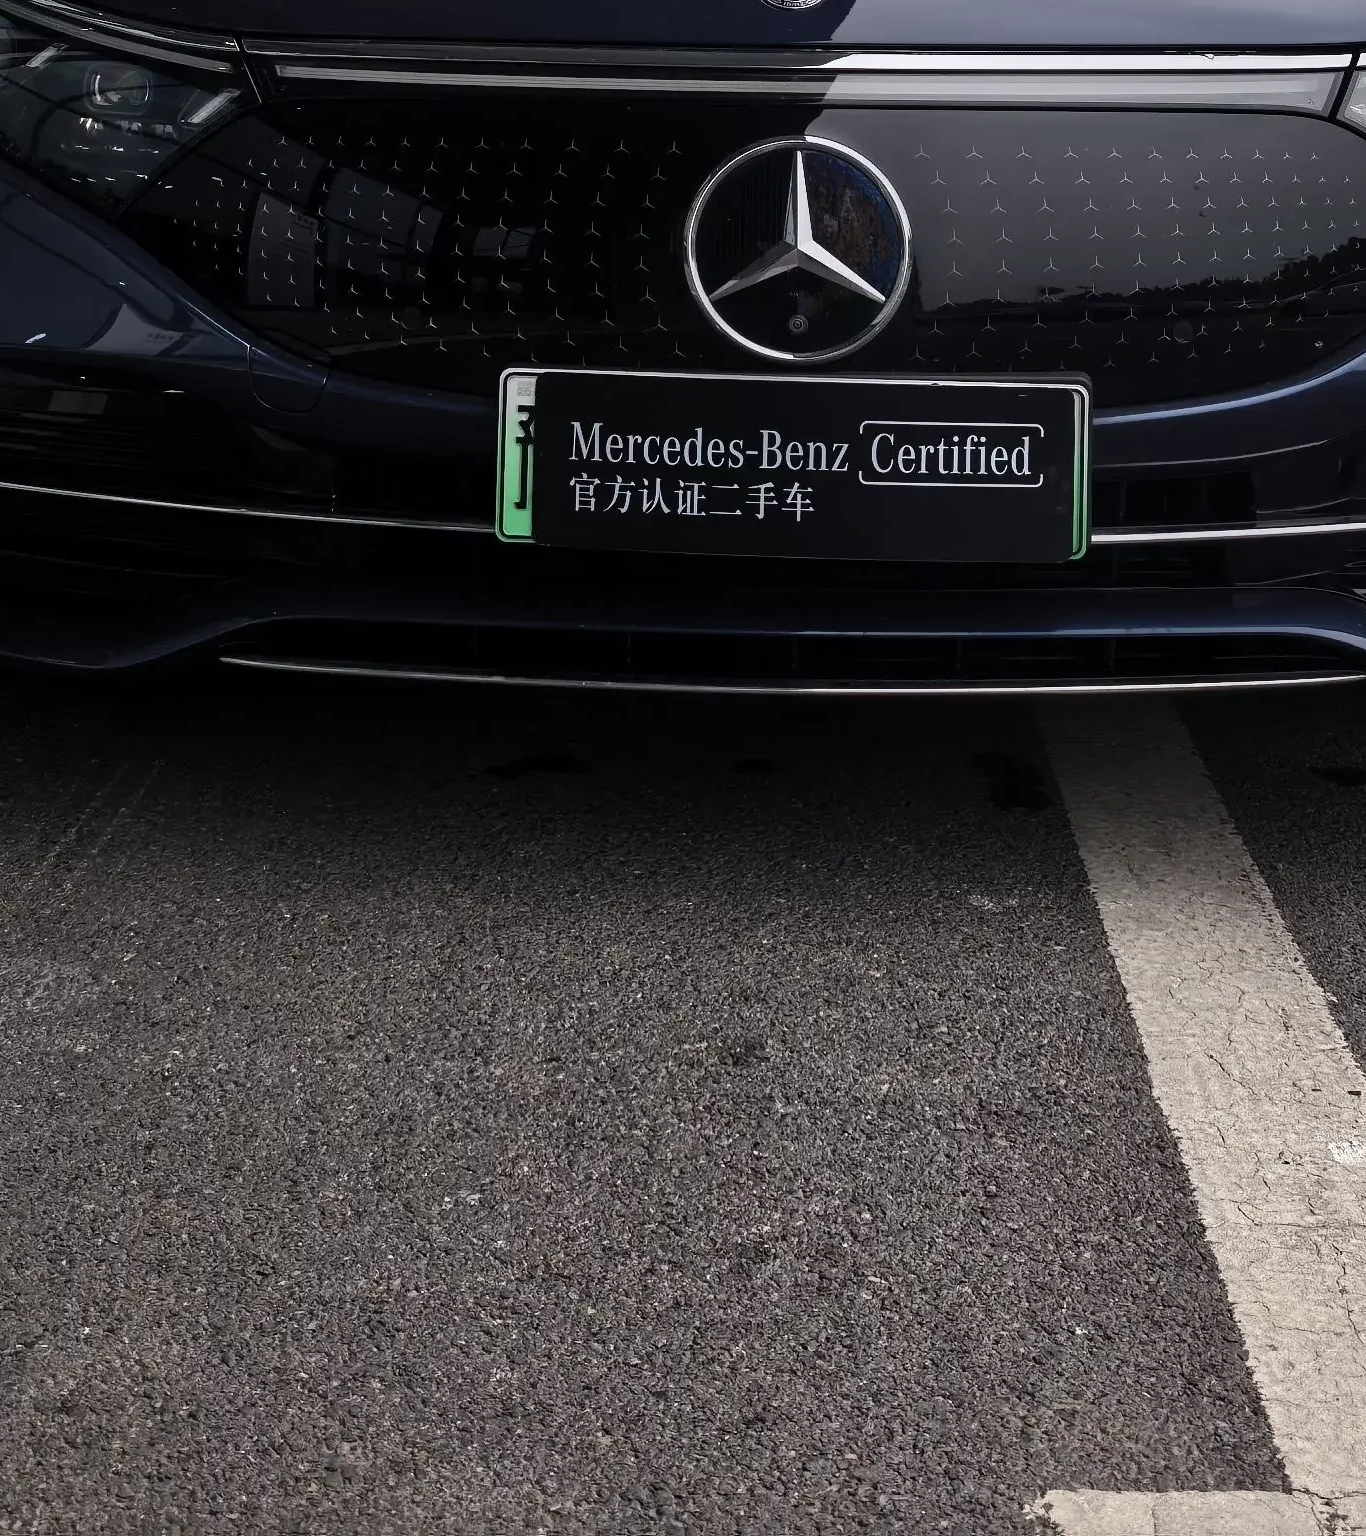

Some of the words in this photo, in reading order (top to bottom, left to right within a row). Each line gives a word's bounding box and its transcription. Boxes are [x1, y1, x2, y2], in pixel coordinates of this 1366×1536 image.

[568, 421, 850, 472] Mercedes-Benz
[871, 432, 1032, 476] Certified
[569, 472, 815, 522] 官方认证二手车
